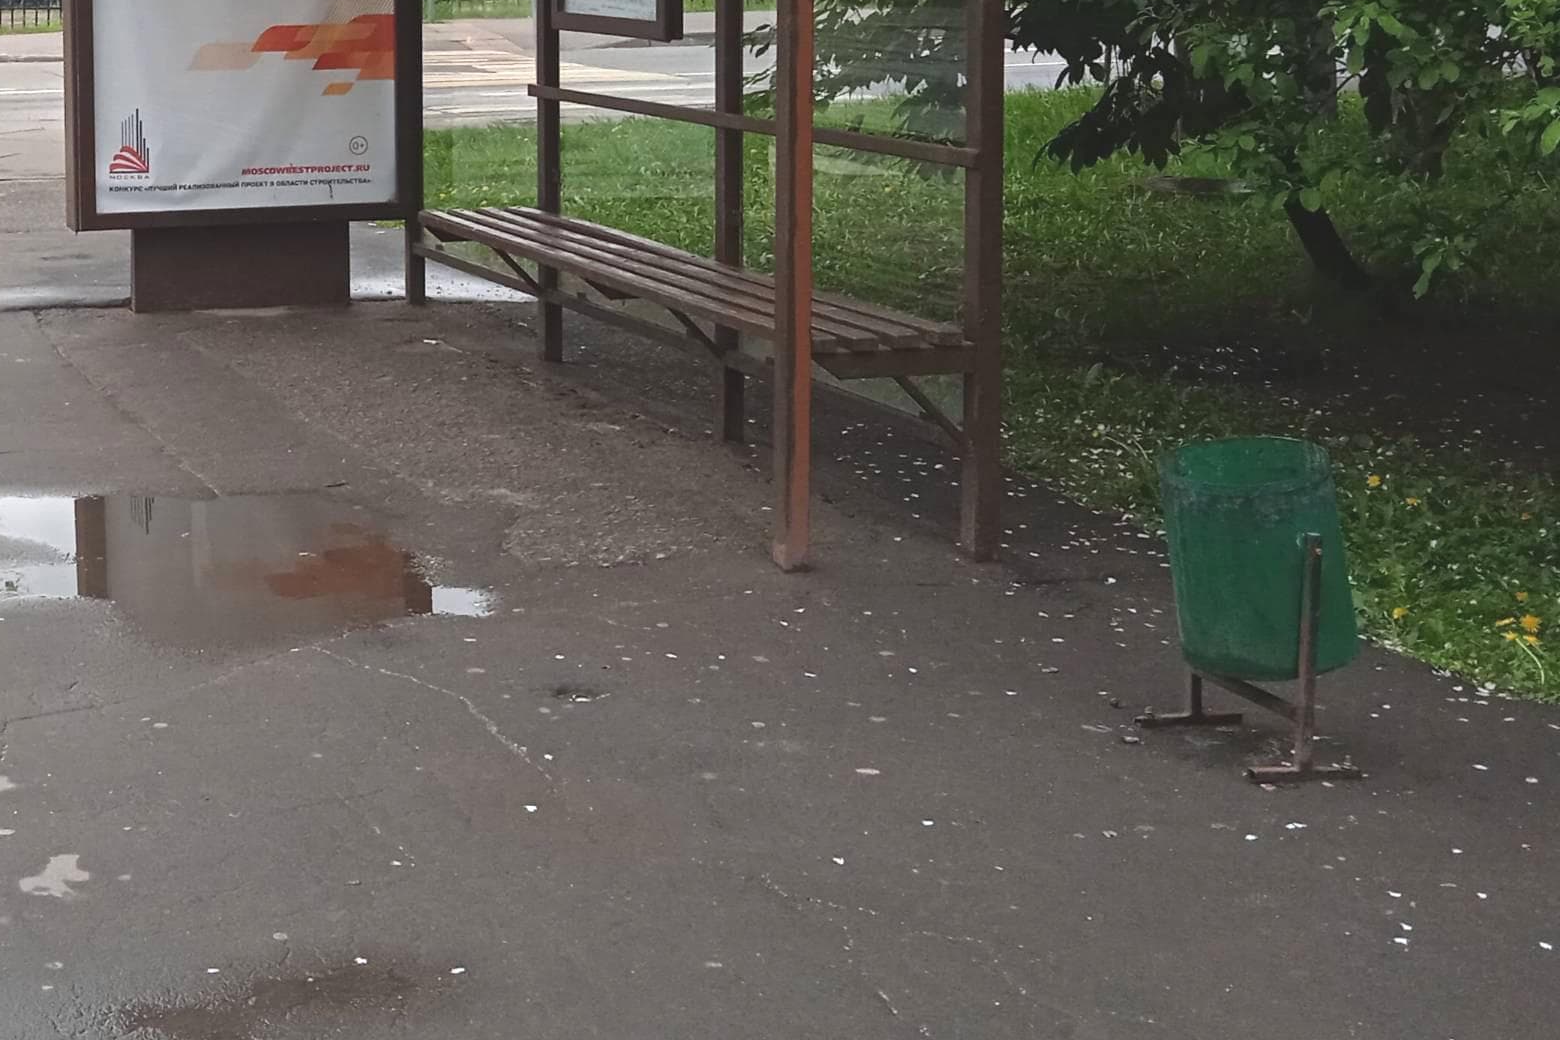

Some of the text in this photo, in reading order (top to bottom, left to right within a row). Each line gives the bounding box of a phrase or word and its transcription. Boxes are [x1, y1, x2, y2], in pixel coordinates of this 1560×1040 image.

[179, 181, 240, 191] РЕАЛИЗОВАННЫЙ
[241, 180, 268, 188] ПРОЕКТ
[276, 179, 309, 187] ОБЛАСТИ
